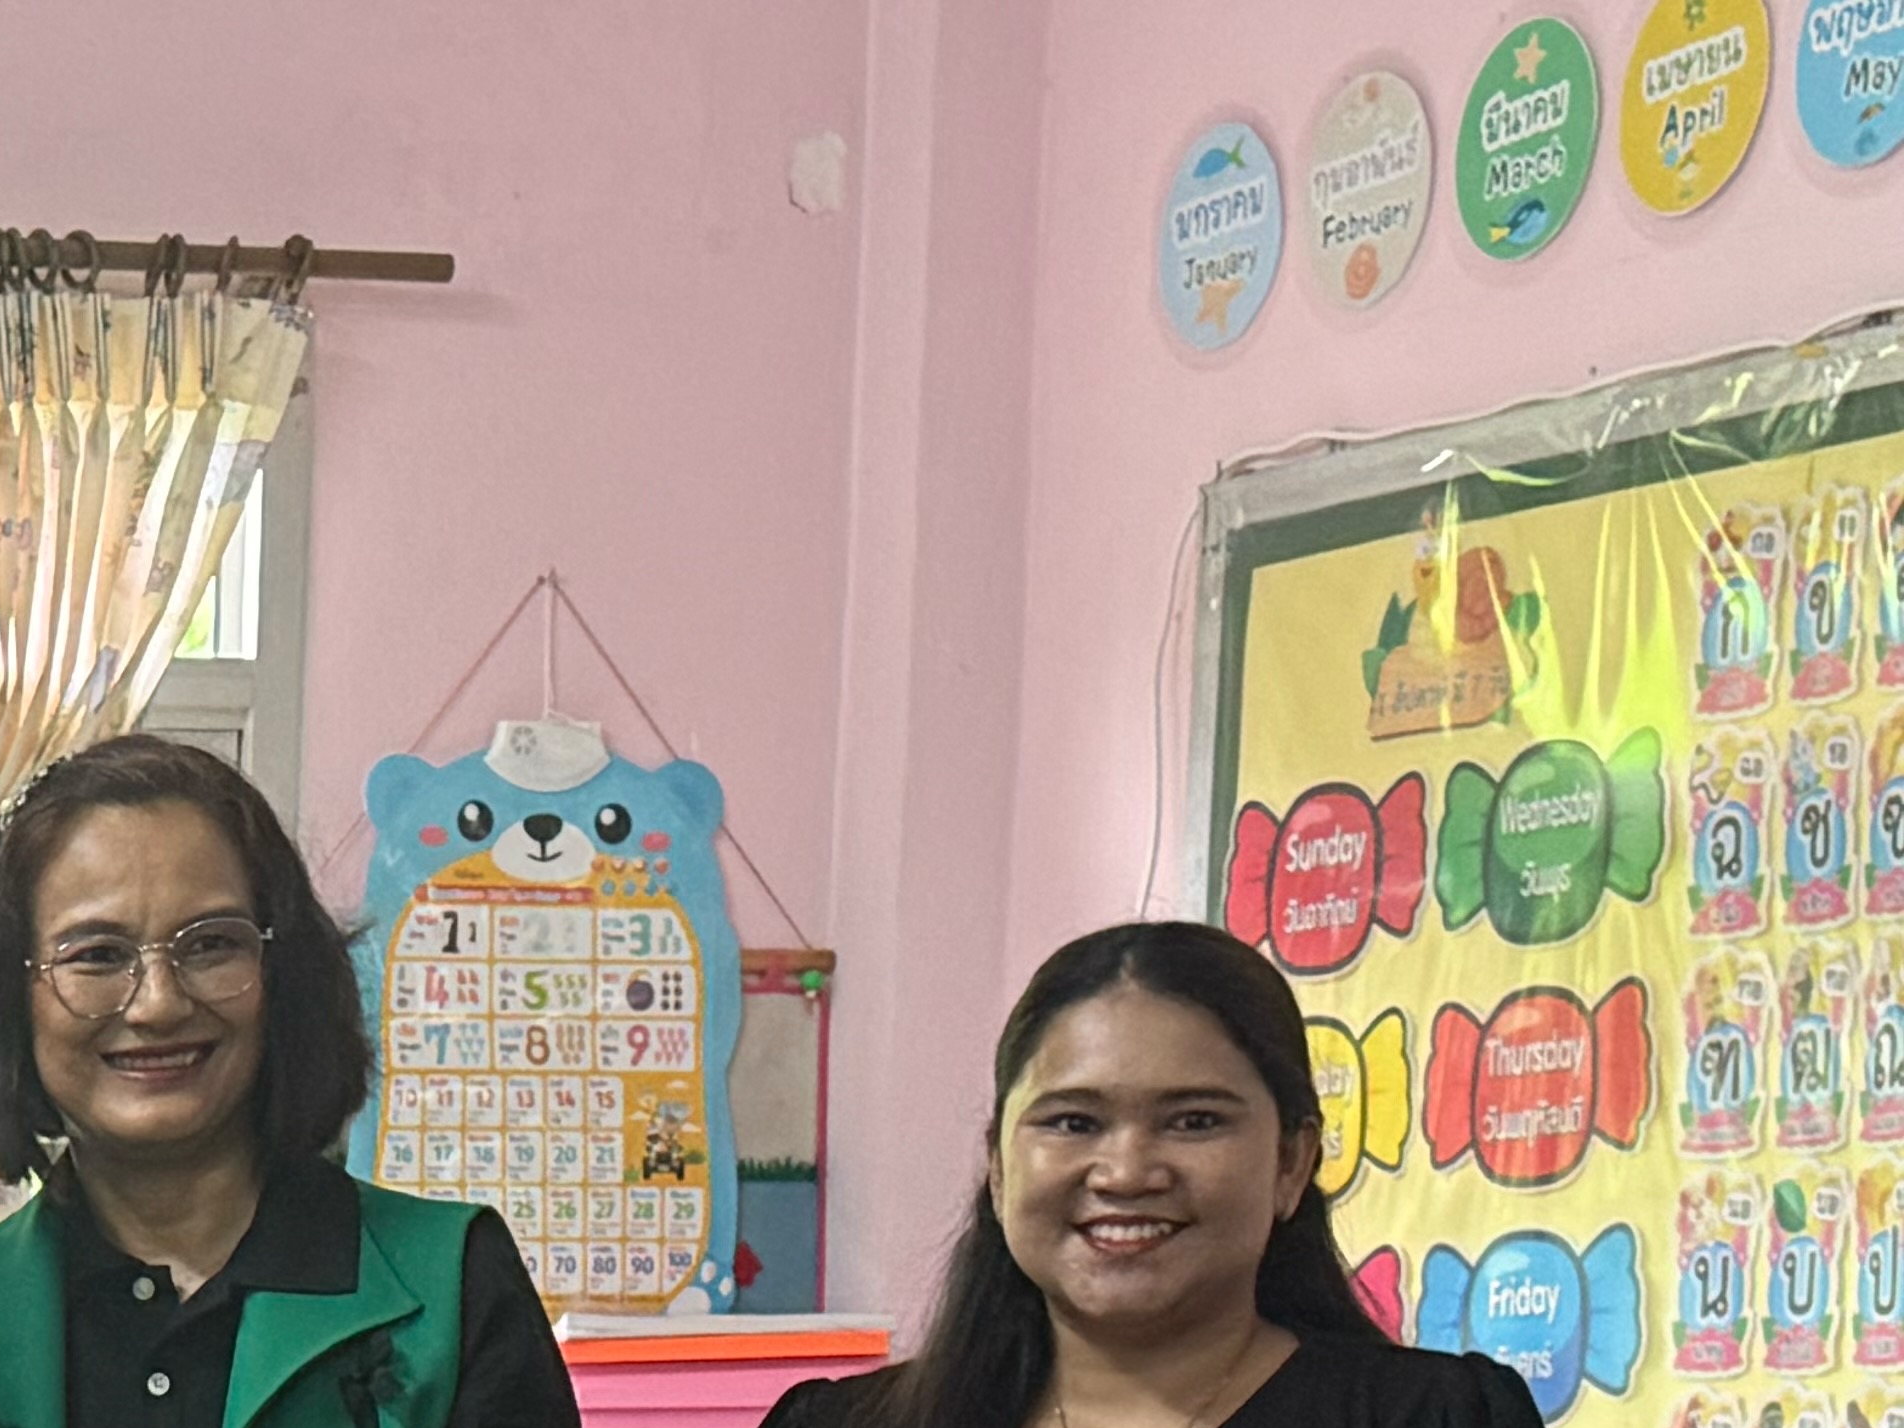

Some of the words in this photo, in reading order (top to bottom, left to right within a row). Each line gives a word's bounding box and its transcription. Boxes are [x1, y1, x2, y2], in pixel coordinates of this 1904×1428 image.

[1644, 39, 1744, 97] เมษายน
[1844, 54, 1904, 97] May
[1483, 88, 1567, 145] มีนาคม
[1660, 88, 1725, 143] April
[1314, 125, 1419, 207] กุมภาพันธ์
[1486, 142, 1566, 197] March
[1174, 183, 1265, 242] มกราคม
[1321, 201, 1414, 248] February
[1183, 246, 1258, 289] January
[1500, 783, 1600, 834] Wednesday
[1285, 825, 1367, 872] Sunday
[1711, 816, 1741, 880] ฉ
[443, 911, 460, 953] 1
[629, 914, 652, 956] 3
[522, 970, 550, 1009] 5
[424, 1023, 451, 1065] 7
[526, 1025, 550, 1065] 8
[627, 1024, 650, 1066] 9
[1485, 1031, 1584, 1078] Thursday
[554, 1145, 577, 1163] 20
[595, 1146, 615, 1163] 21
[553, 1201, 577, 1220] 26
[594, 1201, 616, 1220] 27
[633, 1201, 655, 1220] 28
[673, 1201, 695, 1220] 29
[555, 1255, 577, 1274] 70
[593, 1255, 617, 1274] 80
[631, 1256, 654, 1274] 90
[1695, 1256, 1729, 1319] น
[1783, 1251, 1817, 1316] บ
[1869, 1225, 1899, 1316] ป
[1488, 1276, 1561, 1325] Friday
